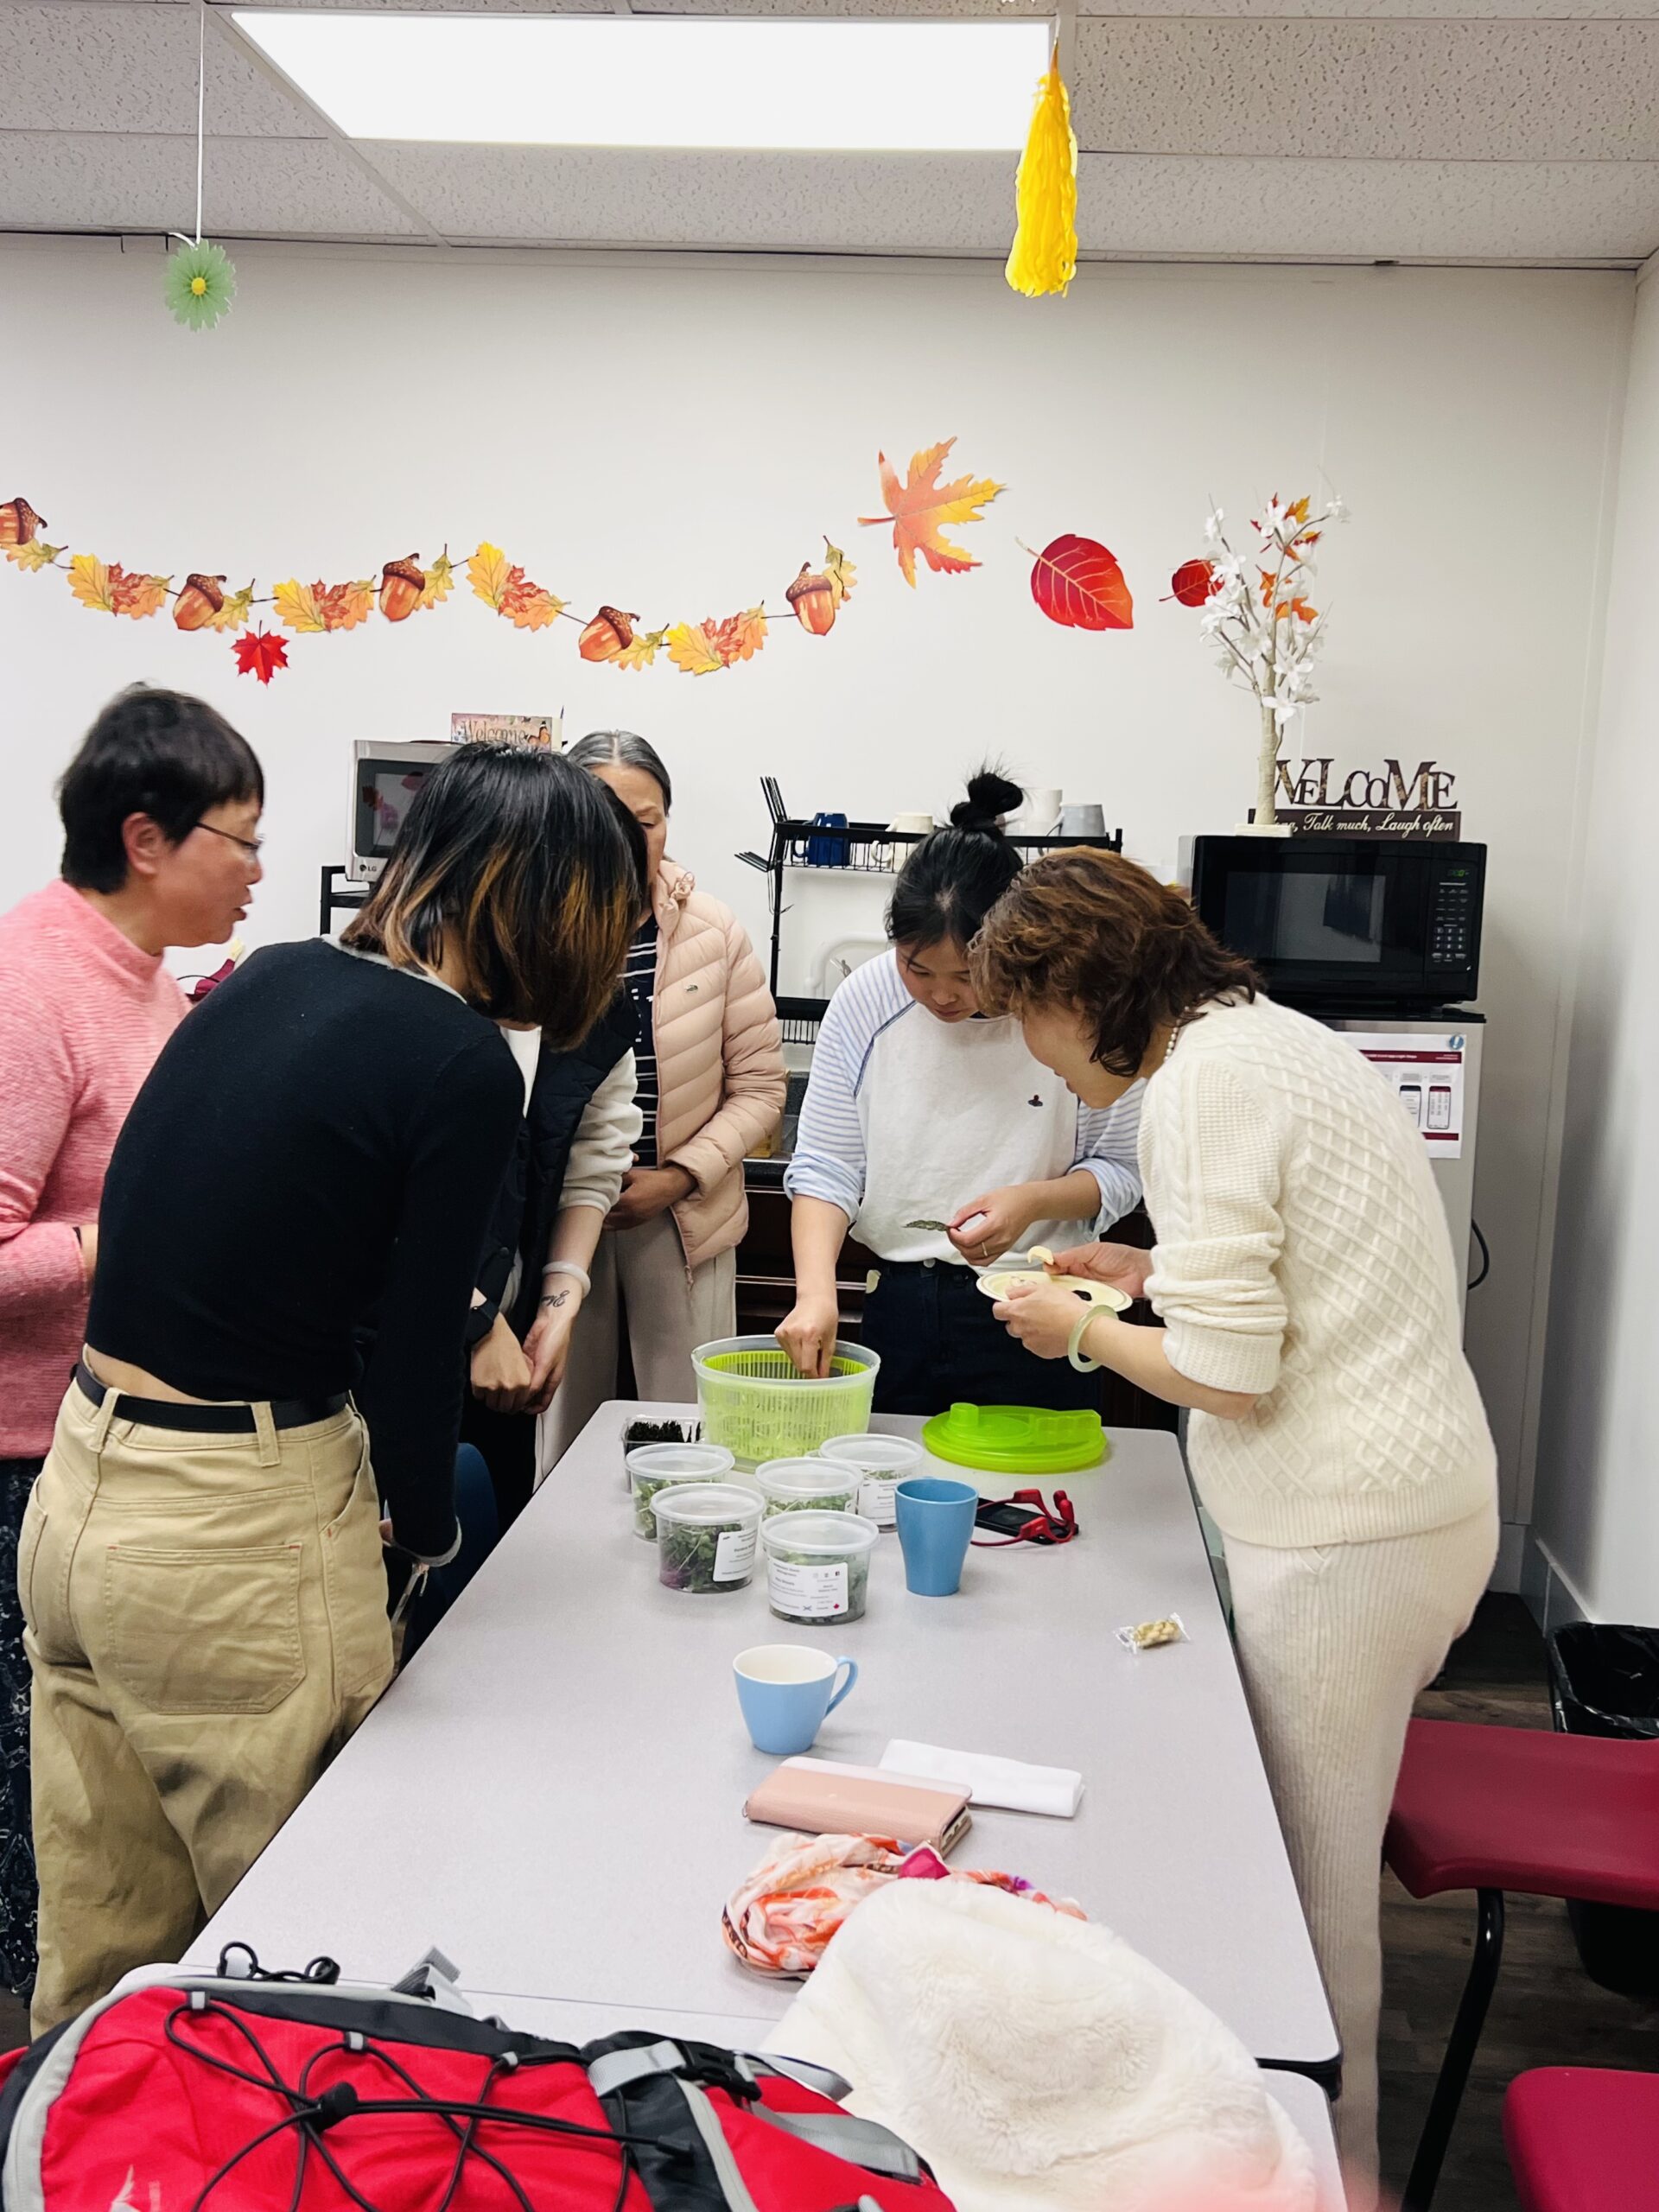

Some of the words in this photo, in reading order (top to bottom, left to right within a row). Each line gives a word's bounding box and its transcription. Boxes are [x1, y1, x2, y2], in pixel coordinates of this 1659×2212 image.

[461, 720, 525, 744] Welcome
[1303, 812, 1334, 830] Talk
[1336, 815, 1371, 832] much,
[1376, 812, 1421, 838] Laugh
[1422, 814, 1453, 838] often
